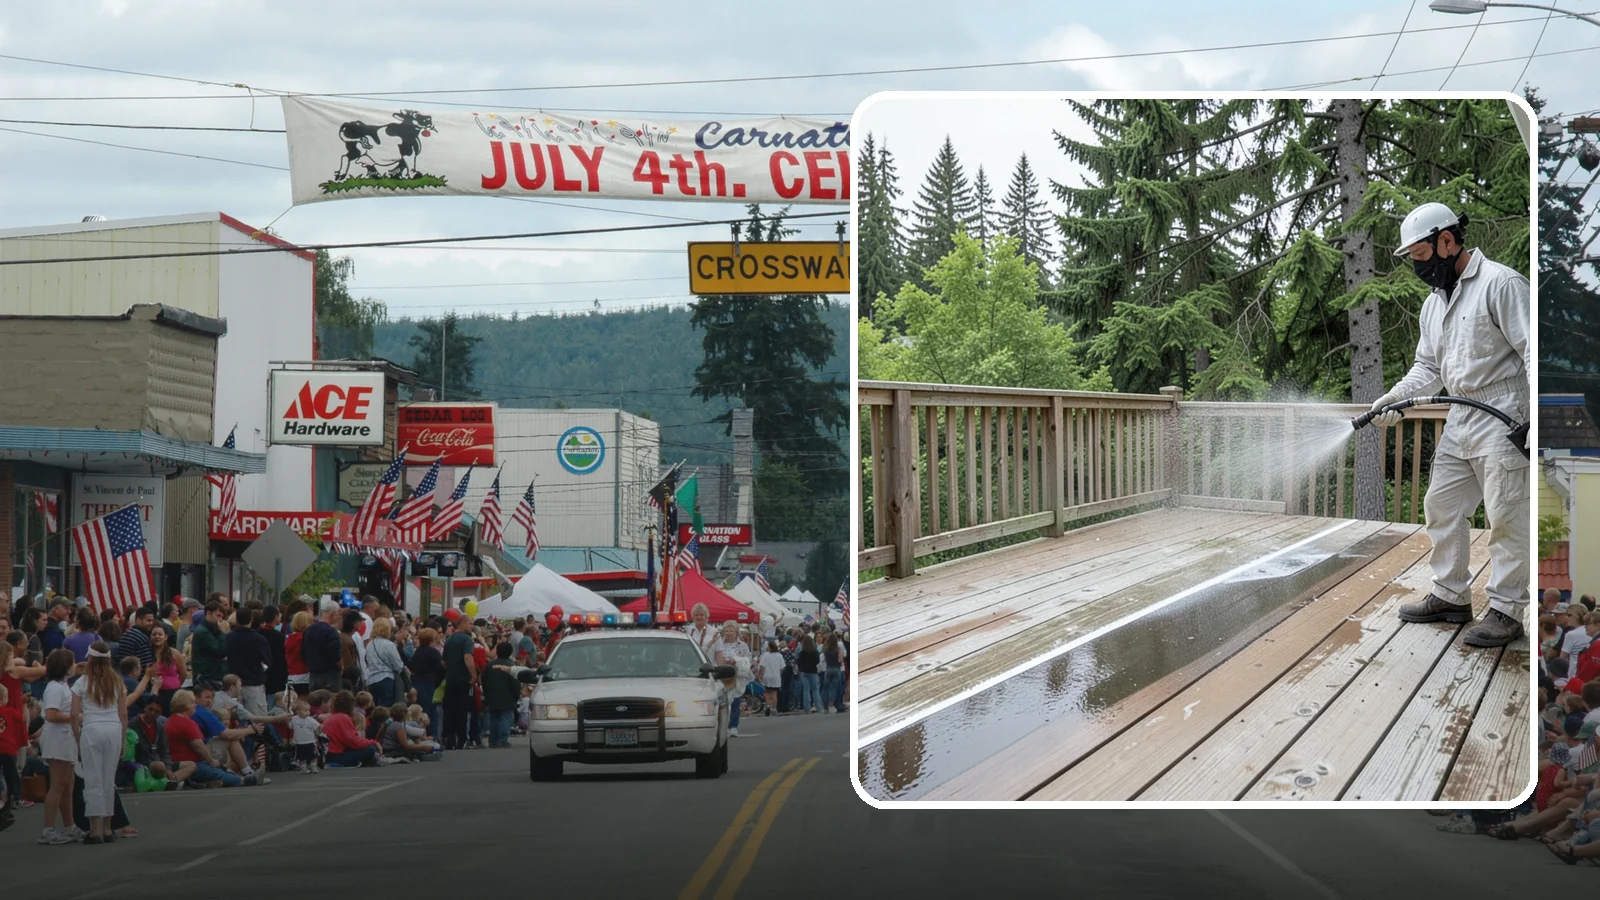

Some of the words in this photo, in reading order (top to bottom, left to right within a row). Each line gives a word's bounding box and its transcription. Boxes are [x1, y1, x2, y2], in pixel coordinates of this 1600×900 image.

[694, 121, 850, 150] Carnat
[481, 141, 605, 192] JULY
[632, 150, 746, 198] 4th.
[697, 254, 850, 280] CROSSWA
[282, 380, 373, 420] ACE
[406, 409, 452, 422] CEDAR
[461, 409, 485, 421] LOG
[283, 421, 370, 436] Hardware
[416, 428, 477, 447] Coca-Cola
[96, 485, 124, 495] Vincent
[126, 486, 136, 495] de
[137, 486, 155, 495] Paul
[212, 516, 330, 535] HARDARE
[688, 527, 741, 535] CRNATION
[699, 535, 730, 544] GLASS
